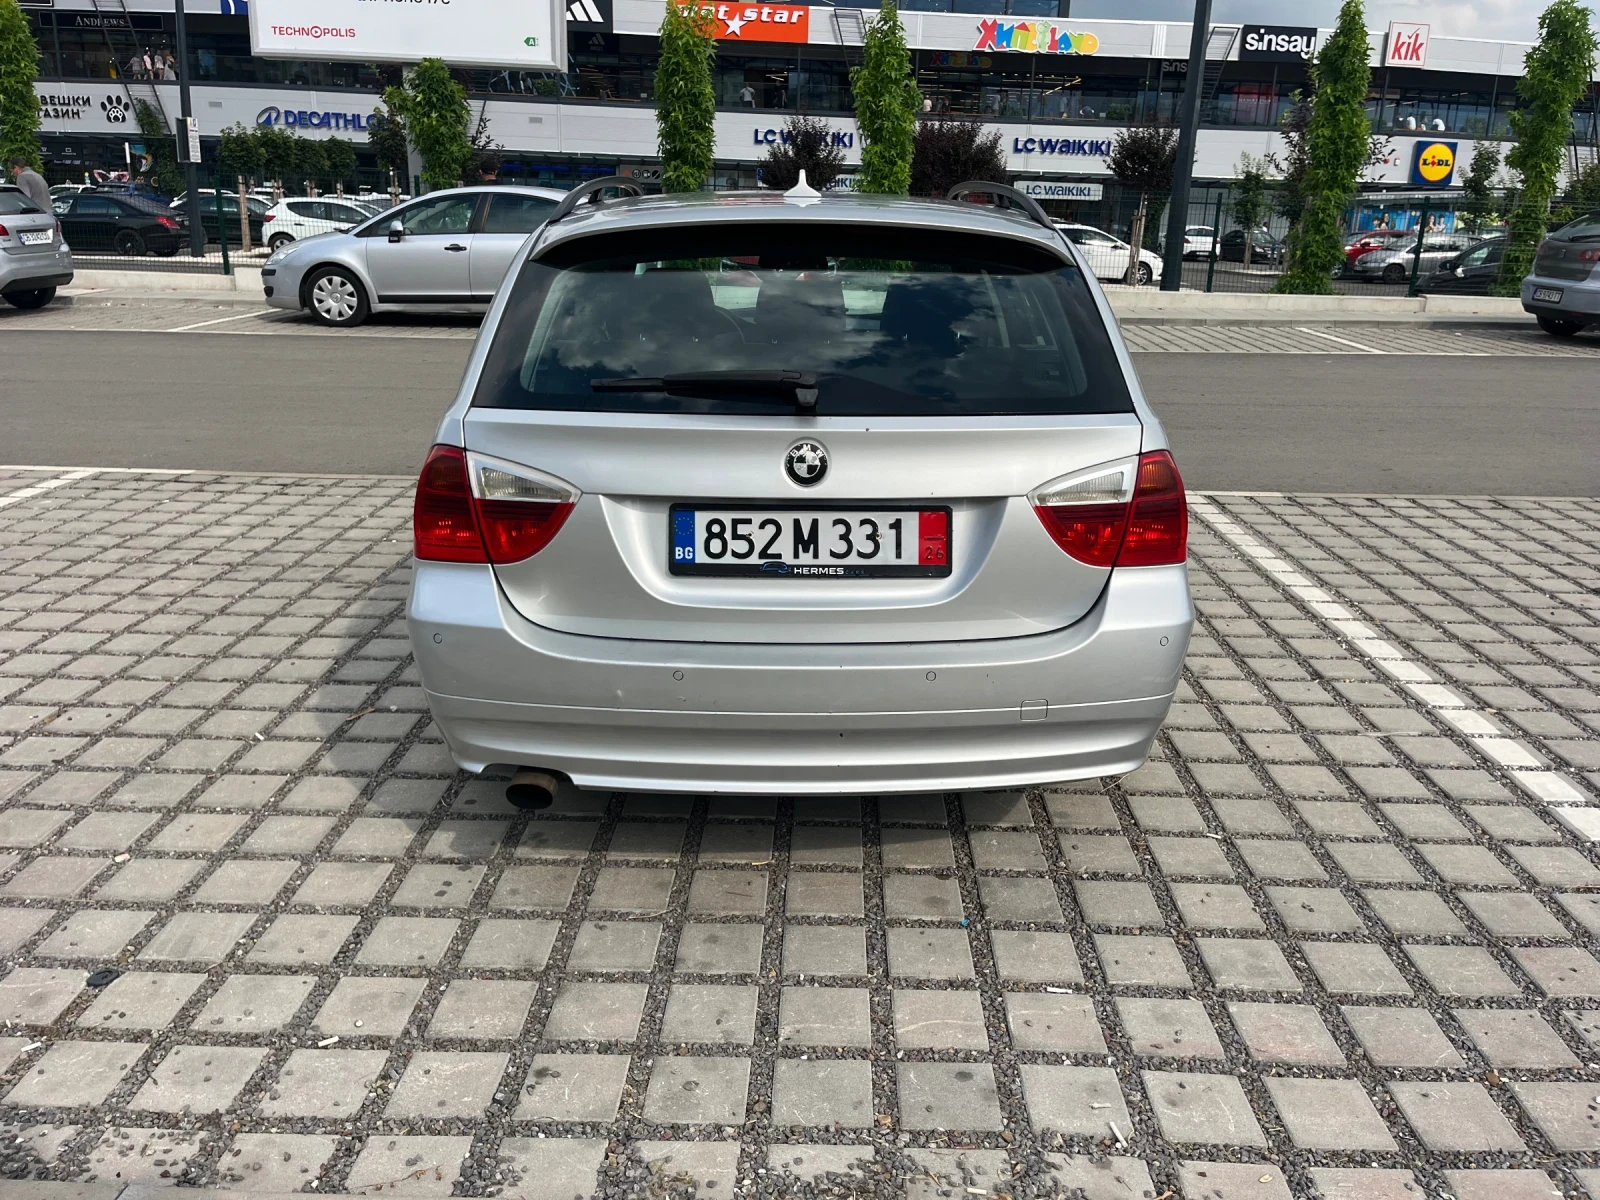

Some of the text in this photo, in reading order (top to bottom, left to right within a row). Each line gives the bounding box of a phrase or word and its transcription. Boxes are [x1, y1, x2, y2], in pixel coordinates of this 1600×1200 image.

[743, 7, 804, 23] star
[271, 26, 356, 38] TECHNOPOLIS
[1245, 29, 1317, 60] sinsay
[1163, 60, 1187, 72] sins
[40, 95, 91, 107] ВЕШКИ
[37, 107, 81, 119] ГАЗИН
[284, 110, 386, 131] DECATHLO
[754, 128, 776, 144] LC
[1014, 138, 1036, 153] LC
[1026, 185, 1042, 195] LC
[675, 518, 944, 560] BG 852 M 331 26
[794, 567, 844, 575] HERMES
